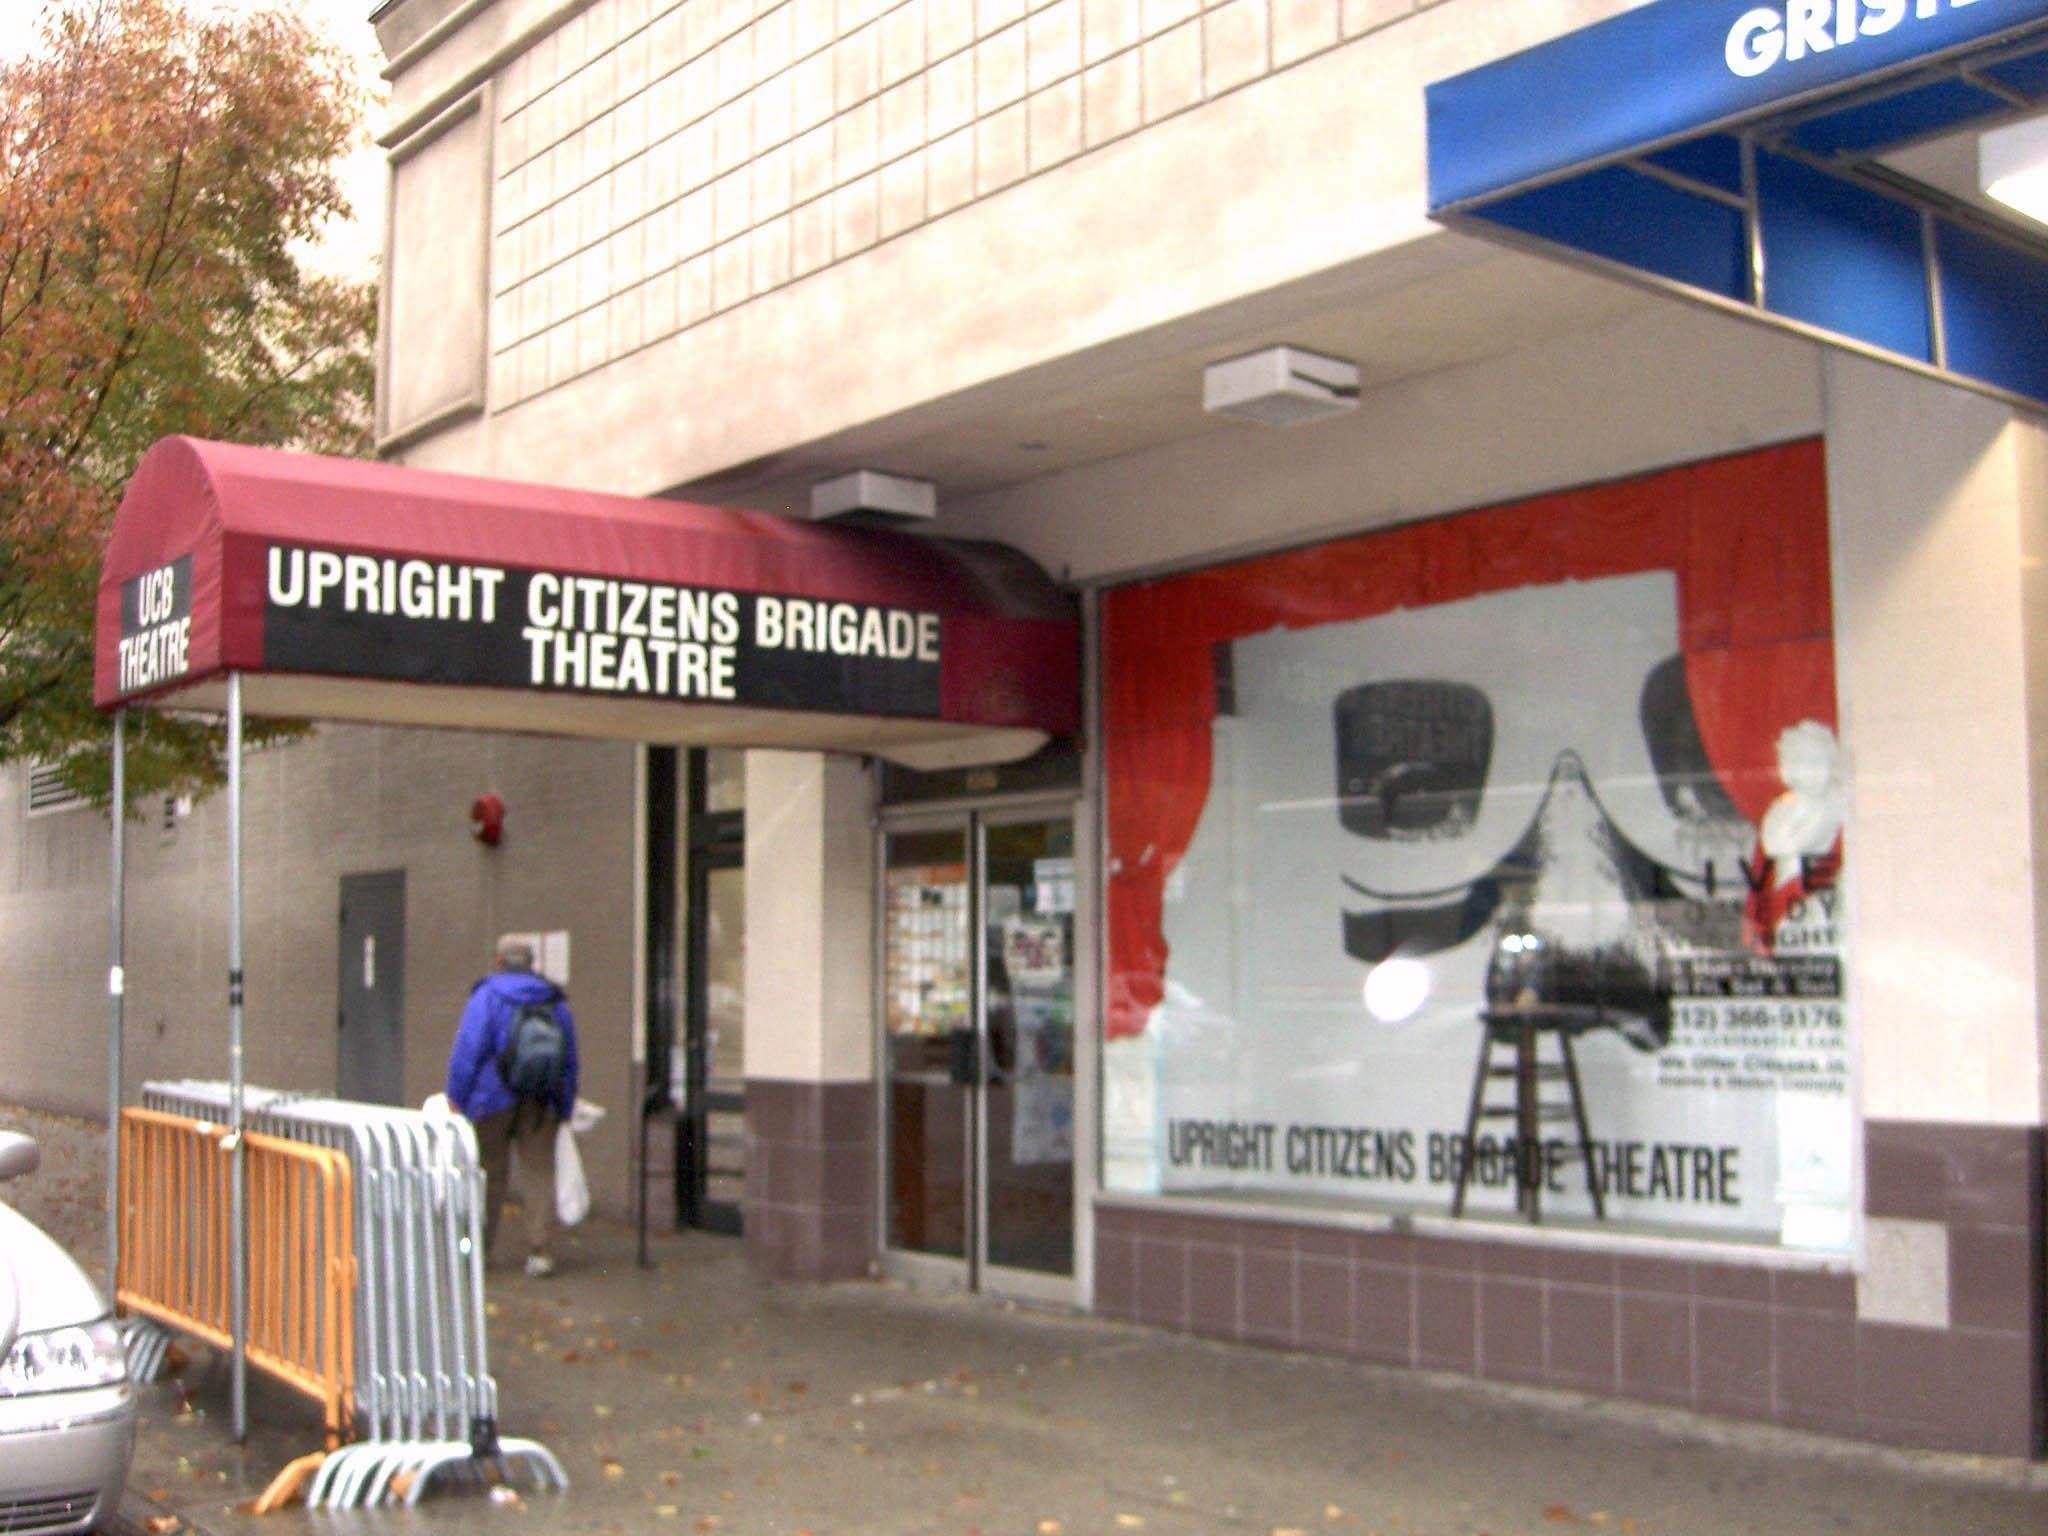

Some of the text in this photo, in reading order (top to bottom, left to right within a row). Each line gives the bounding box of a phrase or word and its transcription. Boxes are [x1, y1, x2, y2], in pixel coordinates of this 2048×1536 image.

[1725, 0, 1983, 77] GRIS
[139, 565, 174, 627] UCB
[268, 547, 940, 662] UPRIGHT CITIZENS BRIGADE
[119, 616, 191, 692] THEATRE
[522, 626, 737, 699] THEATRE
[1168, 1117, 1277, 1171] UPRIGHT
[1285, 1124, 1416, 1182] CITIZENS
